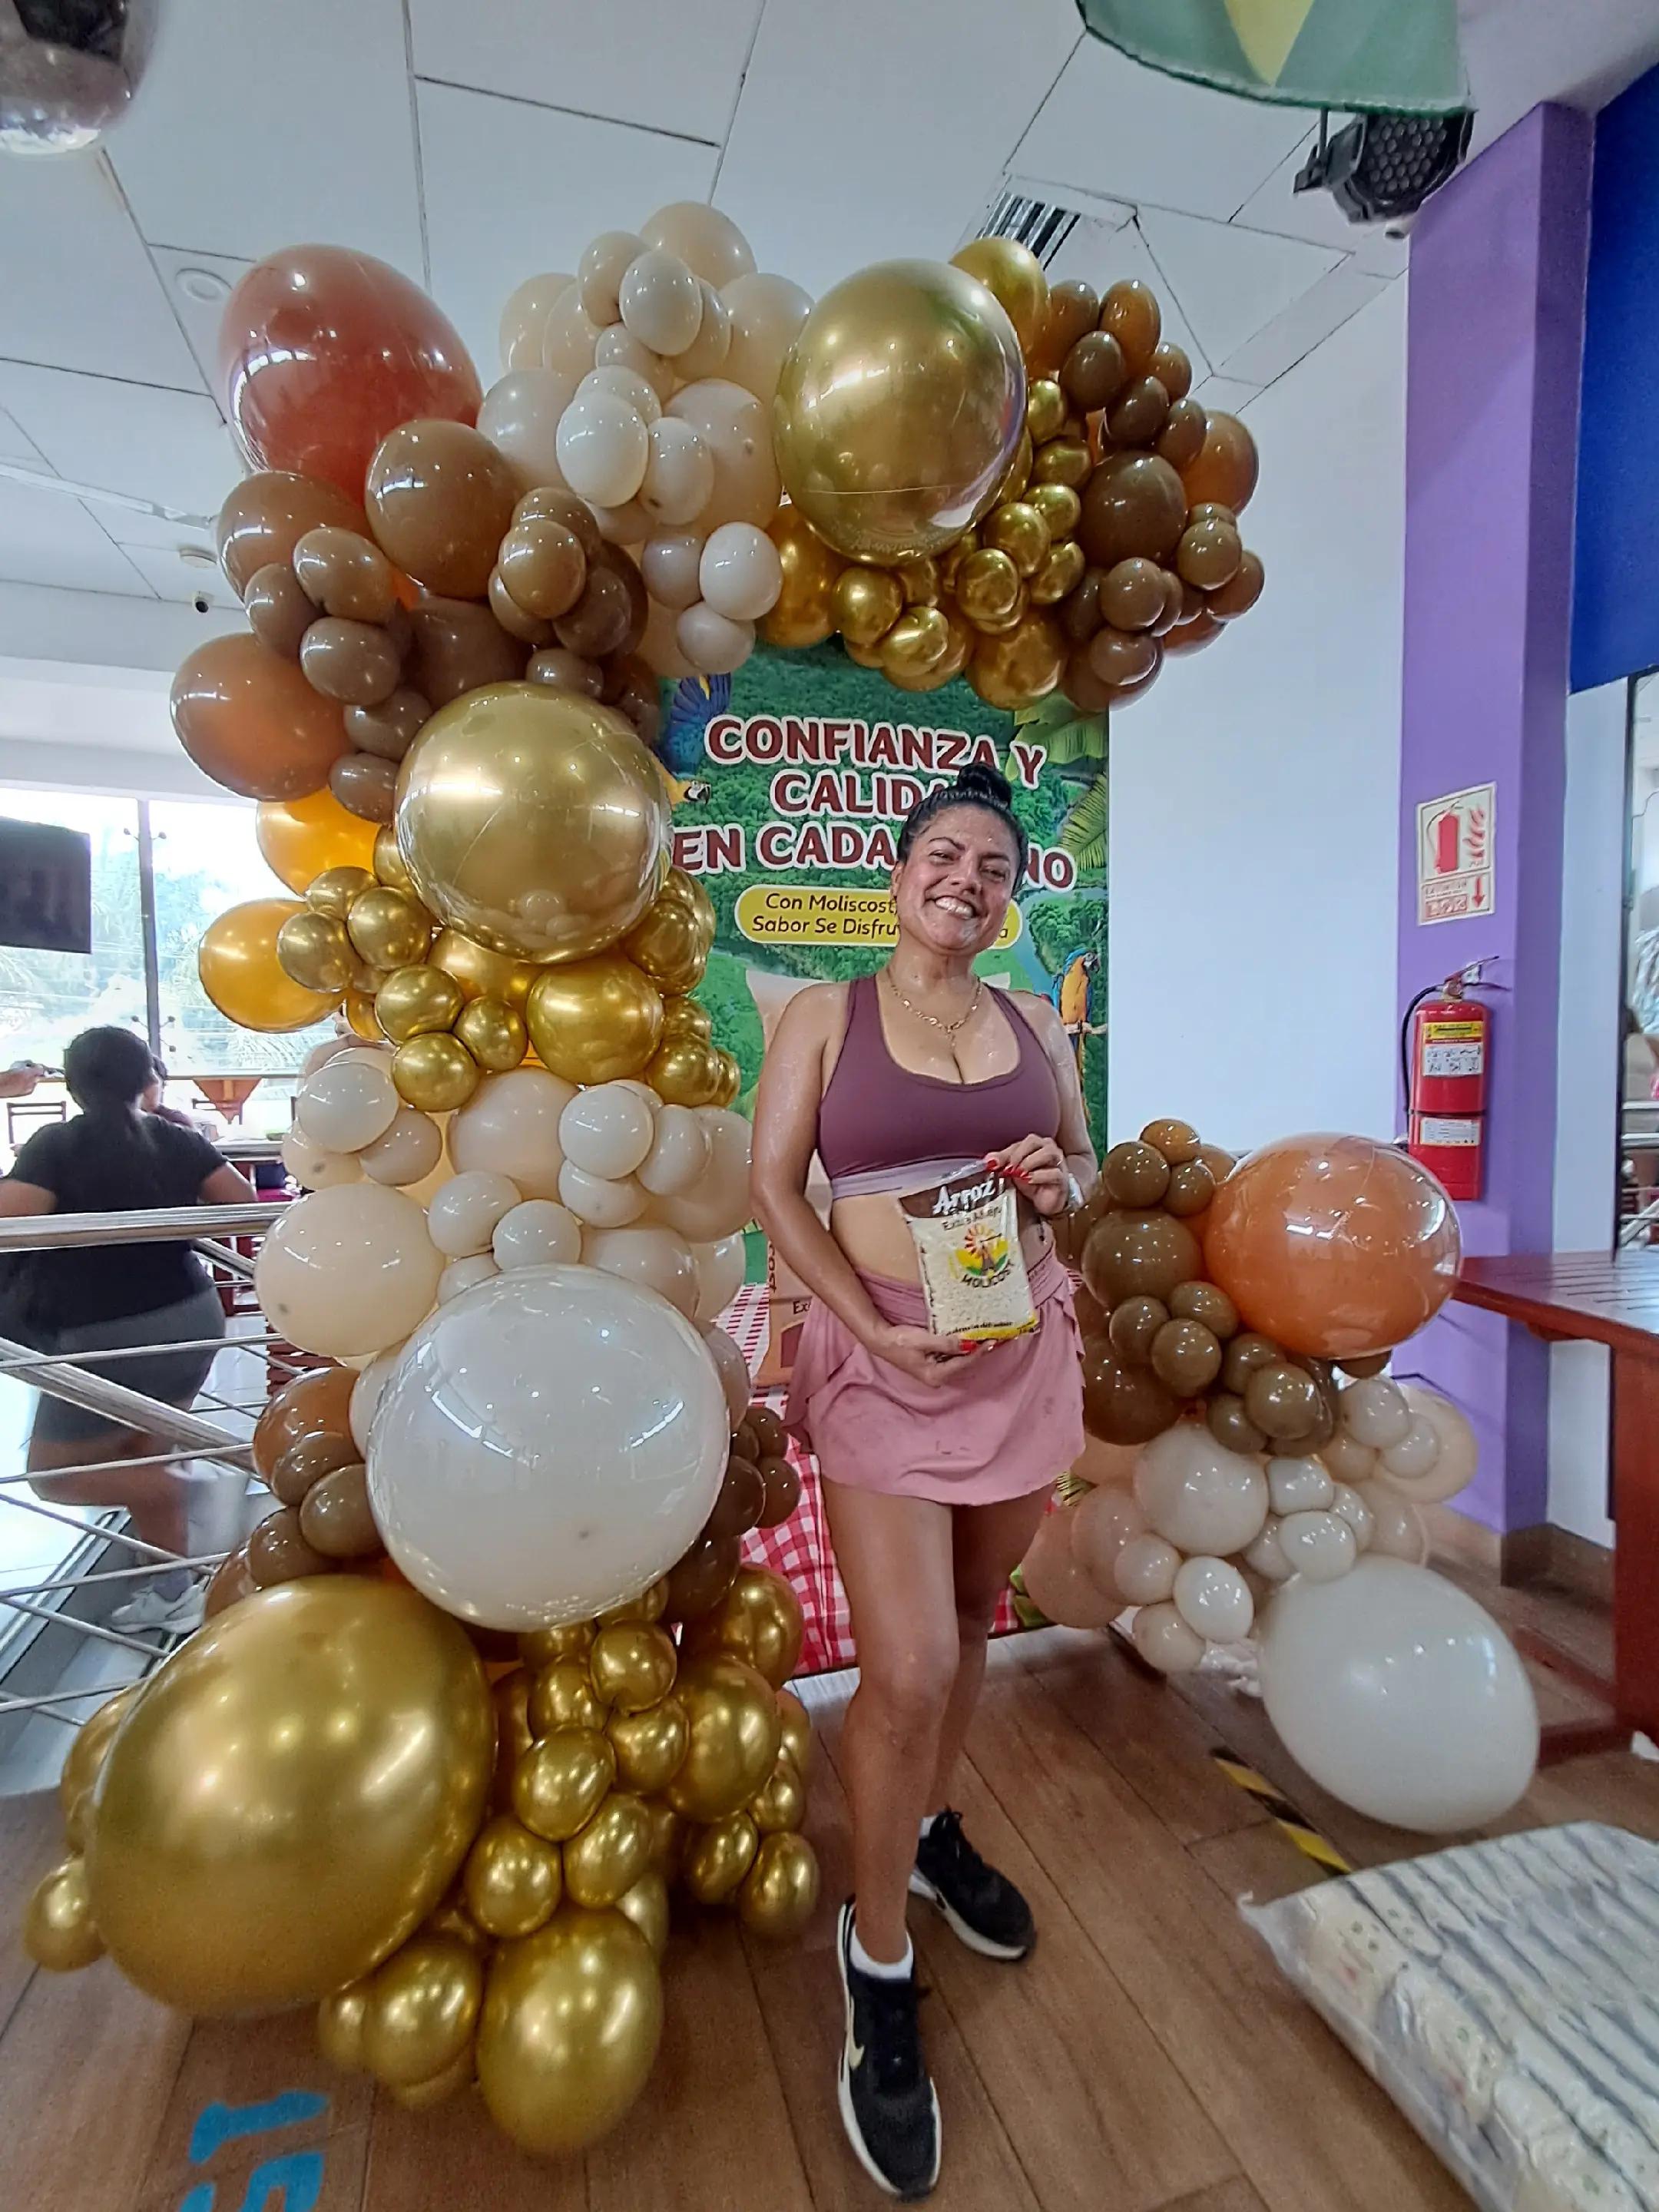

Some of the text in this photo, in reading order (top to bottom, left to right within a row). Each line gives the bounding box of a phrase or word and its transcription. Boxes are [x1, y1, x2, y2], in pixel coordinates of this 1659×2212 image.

[707, 718, 1045, 786] CONFIANZA Y
[773, 772, 945, 816] CALID
[671, 827, 742, 870] EN
[760, 825, 897, 866] CADA
[765, 892, 803, 910] Con
[752, 915, 810, 934] Sabor
[814, 916, 837, 935] Se
[932, 1177, 995, 1214] Arroz
